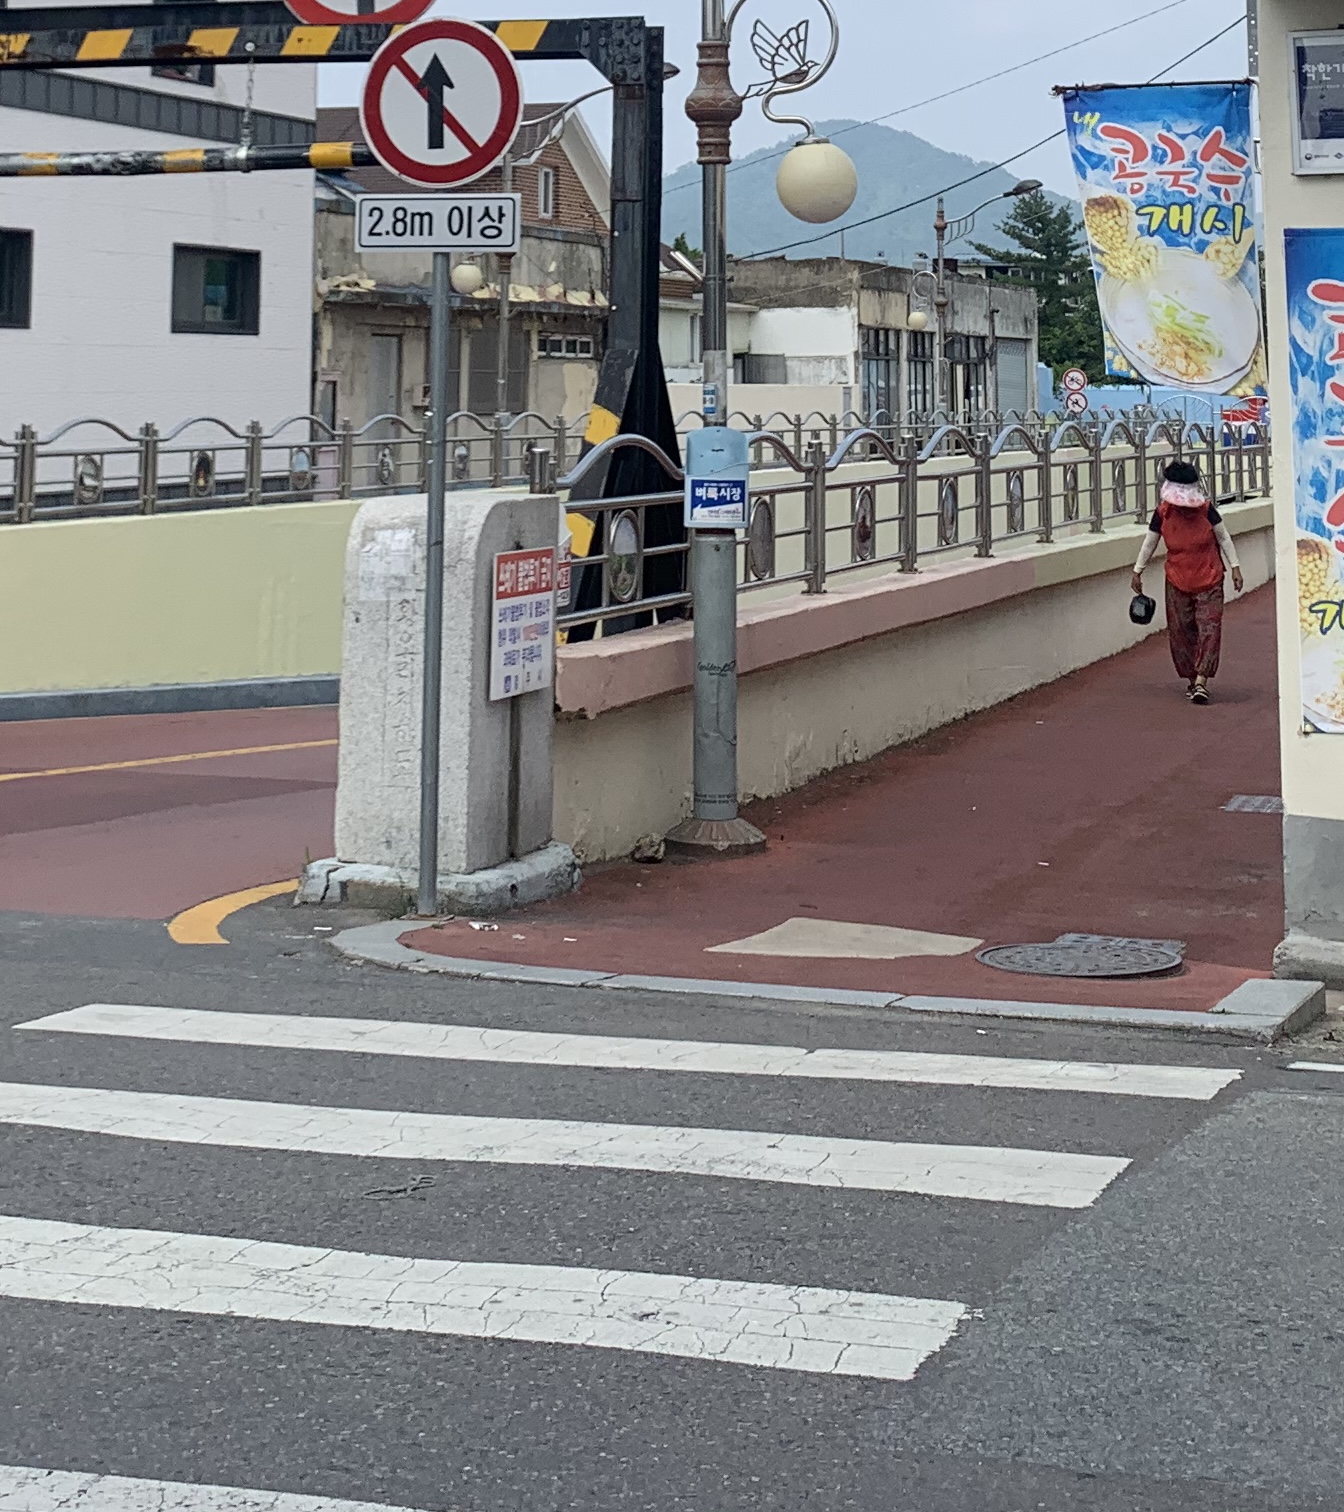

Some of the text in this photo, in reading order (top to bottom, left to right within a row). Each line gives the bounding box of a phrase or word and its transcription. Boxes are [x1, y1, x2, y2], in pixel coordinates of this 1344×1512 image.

[1098, 123, 1250, 204] 콩국수
[367, 206, 507, 240] 2.8m 이상
[1135, 202, 1246, 244] 개시
[695, 487, 742, 501] 벼룩시장
